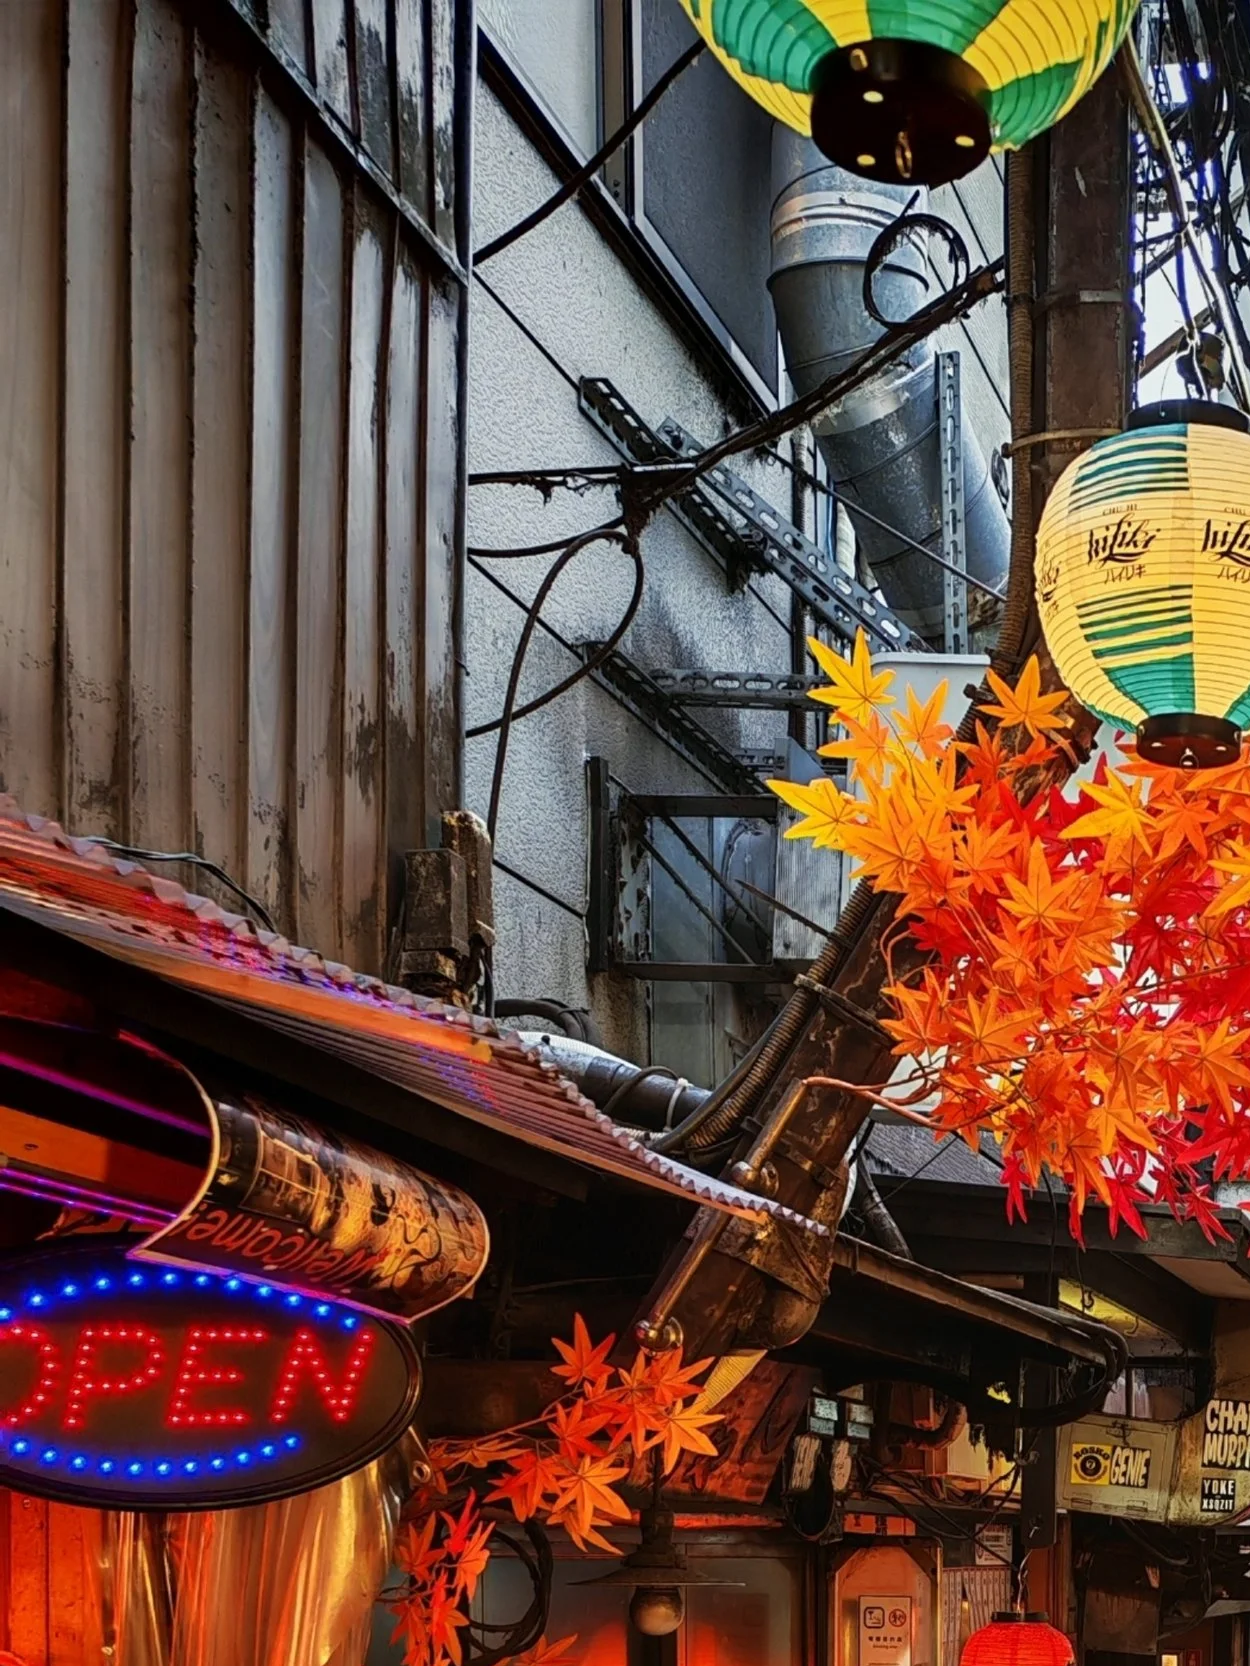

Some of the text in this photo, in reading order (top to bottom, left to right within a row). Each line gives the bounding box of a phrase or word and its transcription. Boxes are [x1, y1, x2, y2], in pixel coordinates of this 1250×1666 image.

[0, 1324, 376, 1430] OPEN
[1111, 1446, 1150, 1488] GENIE
[1203, 1479, 1235, 1496] YOKE
